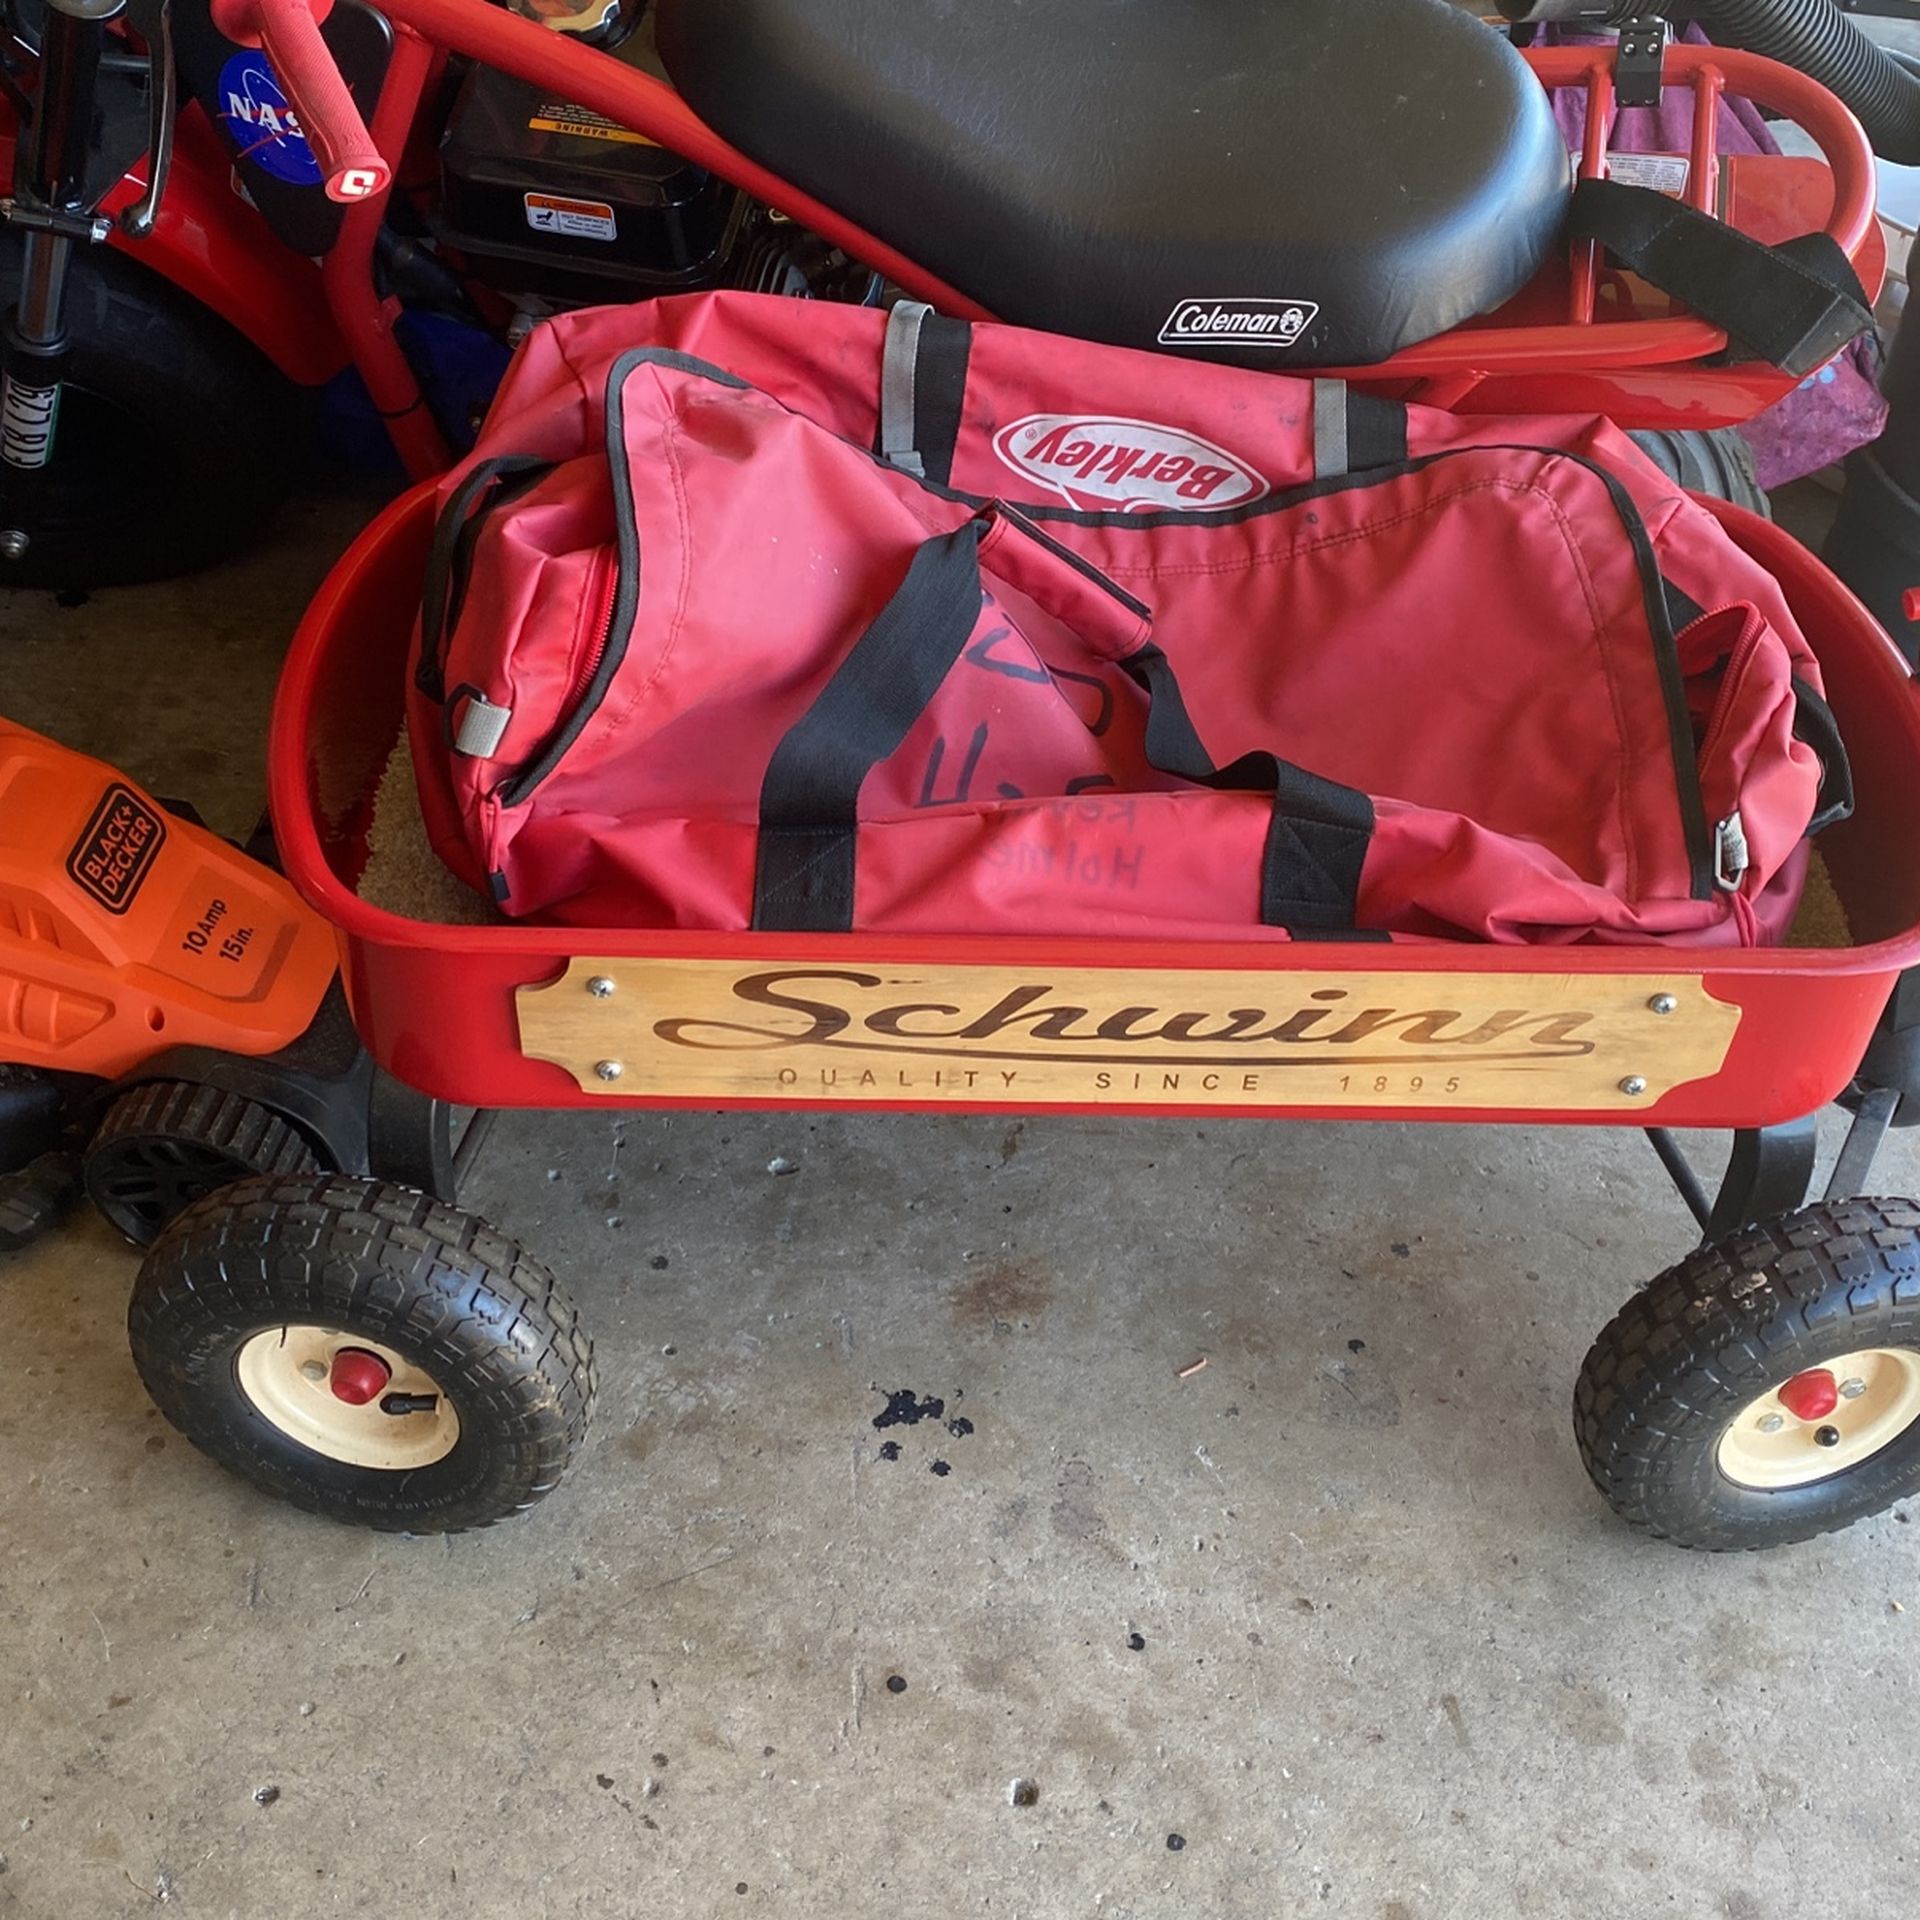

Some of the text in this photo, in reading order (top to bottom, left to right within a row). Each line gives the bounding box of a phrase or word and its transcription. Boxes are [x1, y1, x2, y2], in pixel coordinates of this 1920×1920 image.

[228, 92, 306, 139] NAS
[1176, 305, 1280, 333] Coleman
[1023, 423, 1235, 500] Berkley
[101, 815, 153, 896] DECKER
[652, 969, 1595, 1066] Schwinn
[779, 1067, 1460, 1093] QUALITY SINCE 1895
